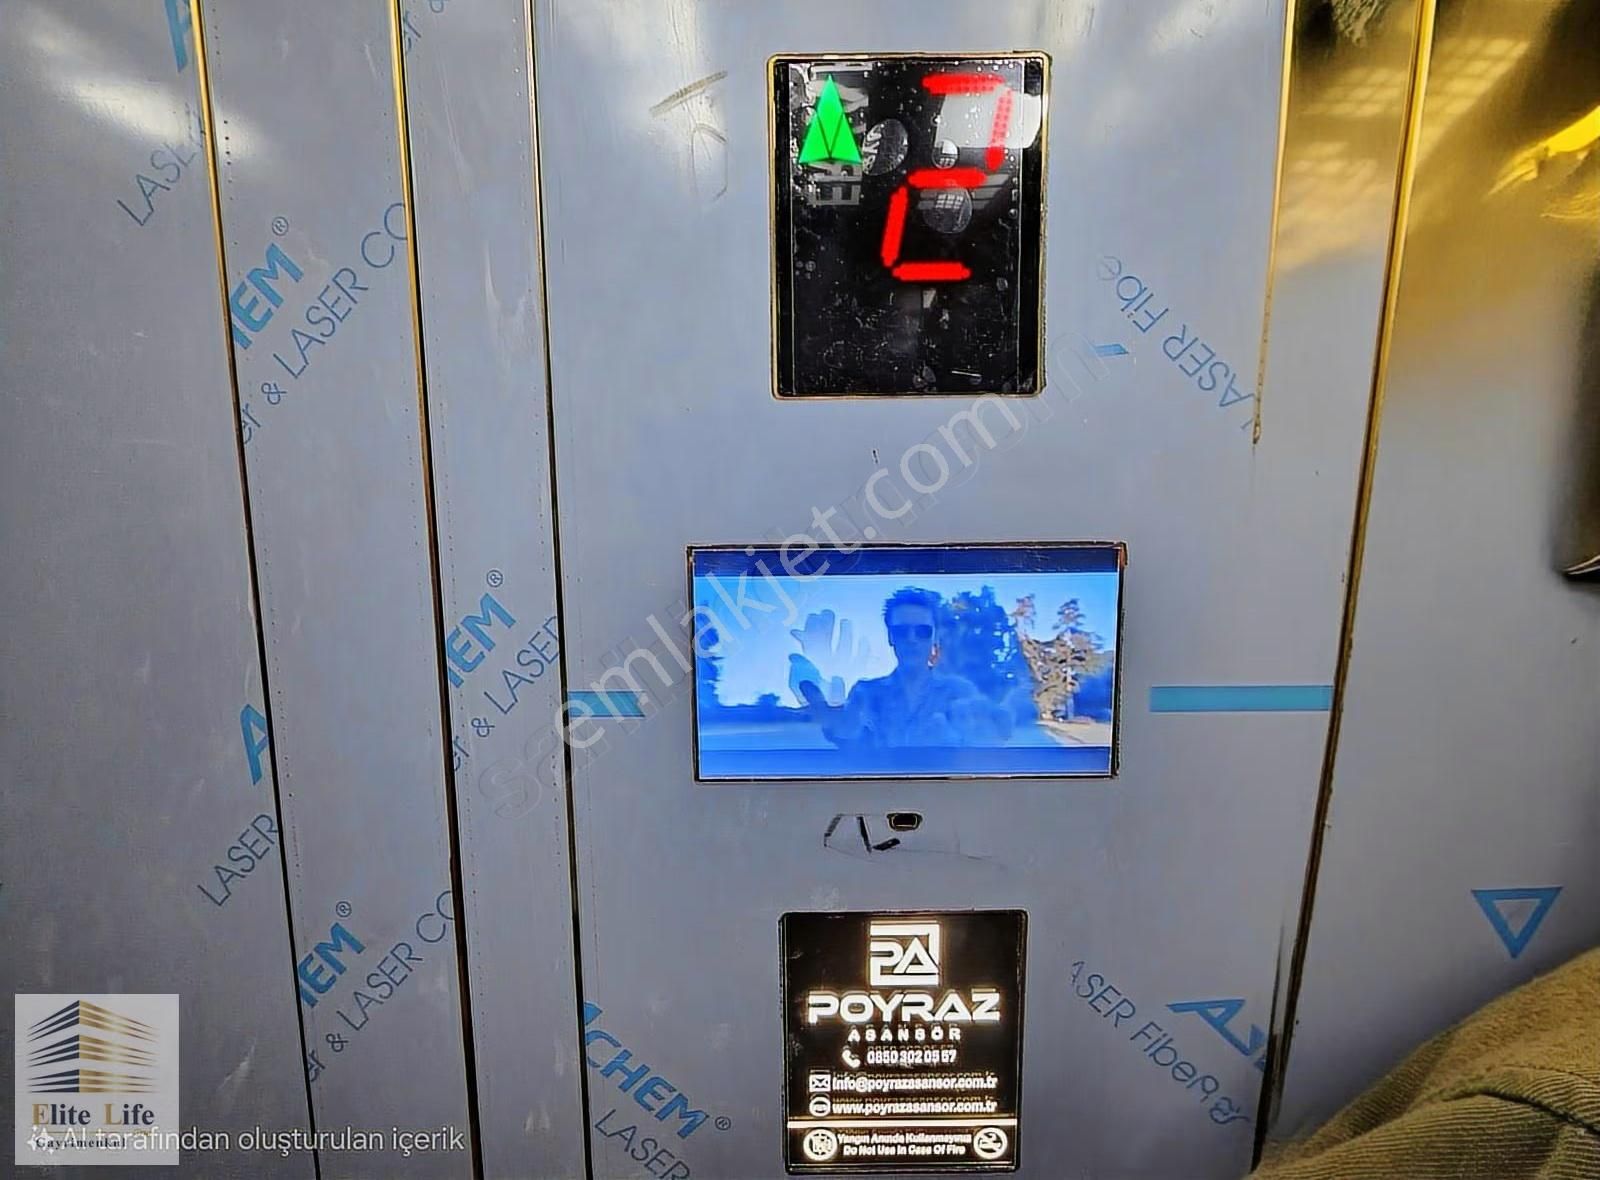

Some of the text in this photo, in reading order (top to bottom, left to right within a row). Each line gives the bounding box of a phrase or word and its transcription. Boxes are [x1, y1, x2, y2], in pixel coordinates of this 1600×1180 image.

[880, 73, 1015, 282] 2
[273, 267, 368, 379] LASER
[197, 813, 279, 907] LASER
[337, 942, 423, 1032] LASER
[808, 991, 1001, 1024] POYRAZ
